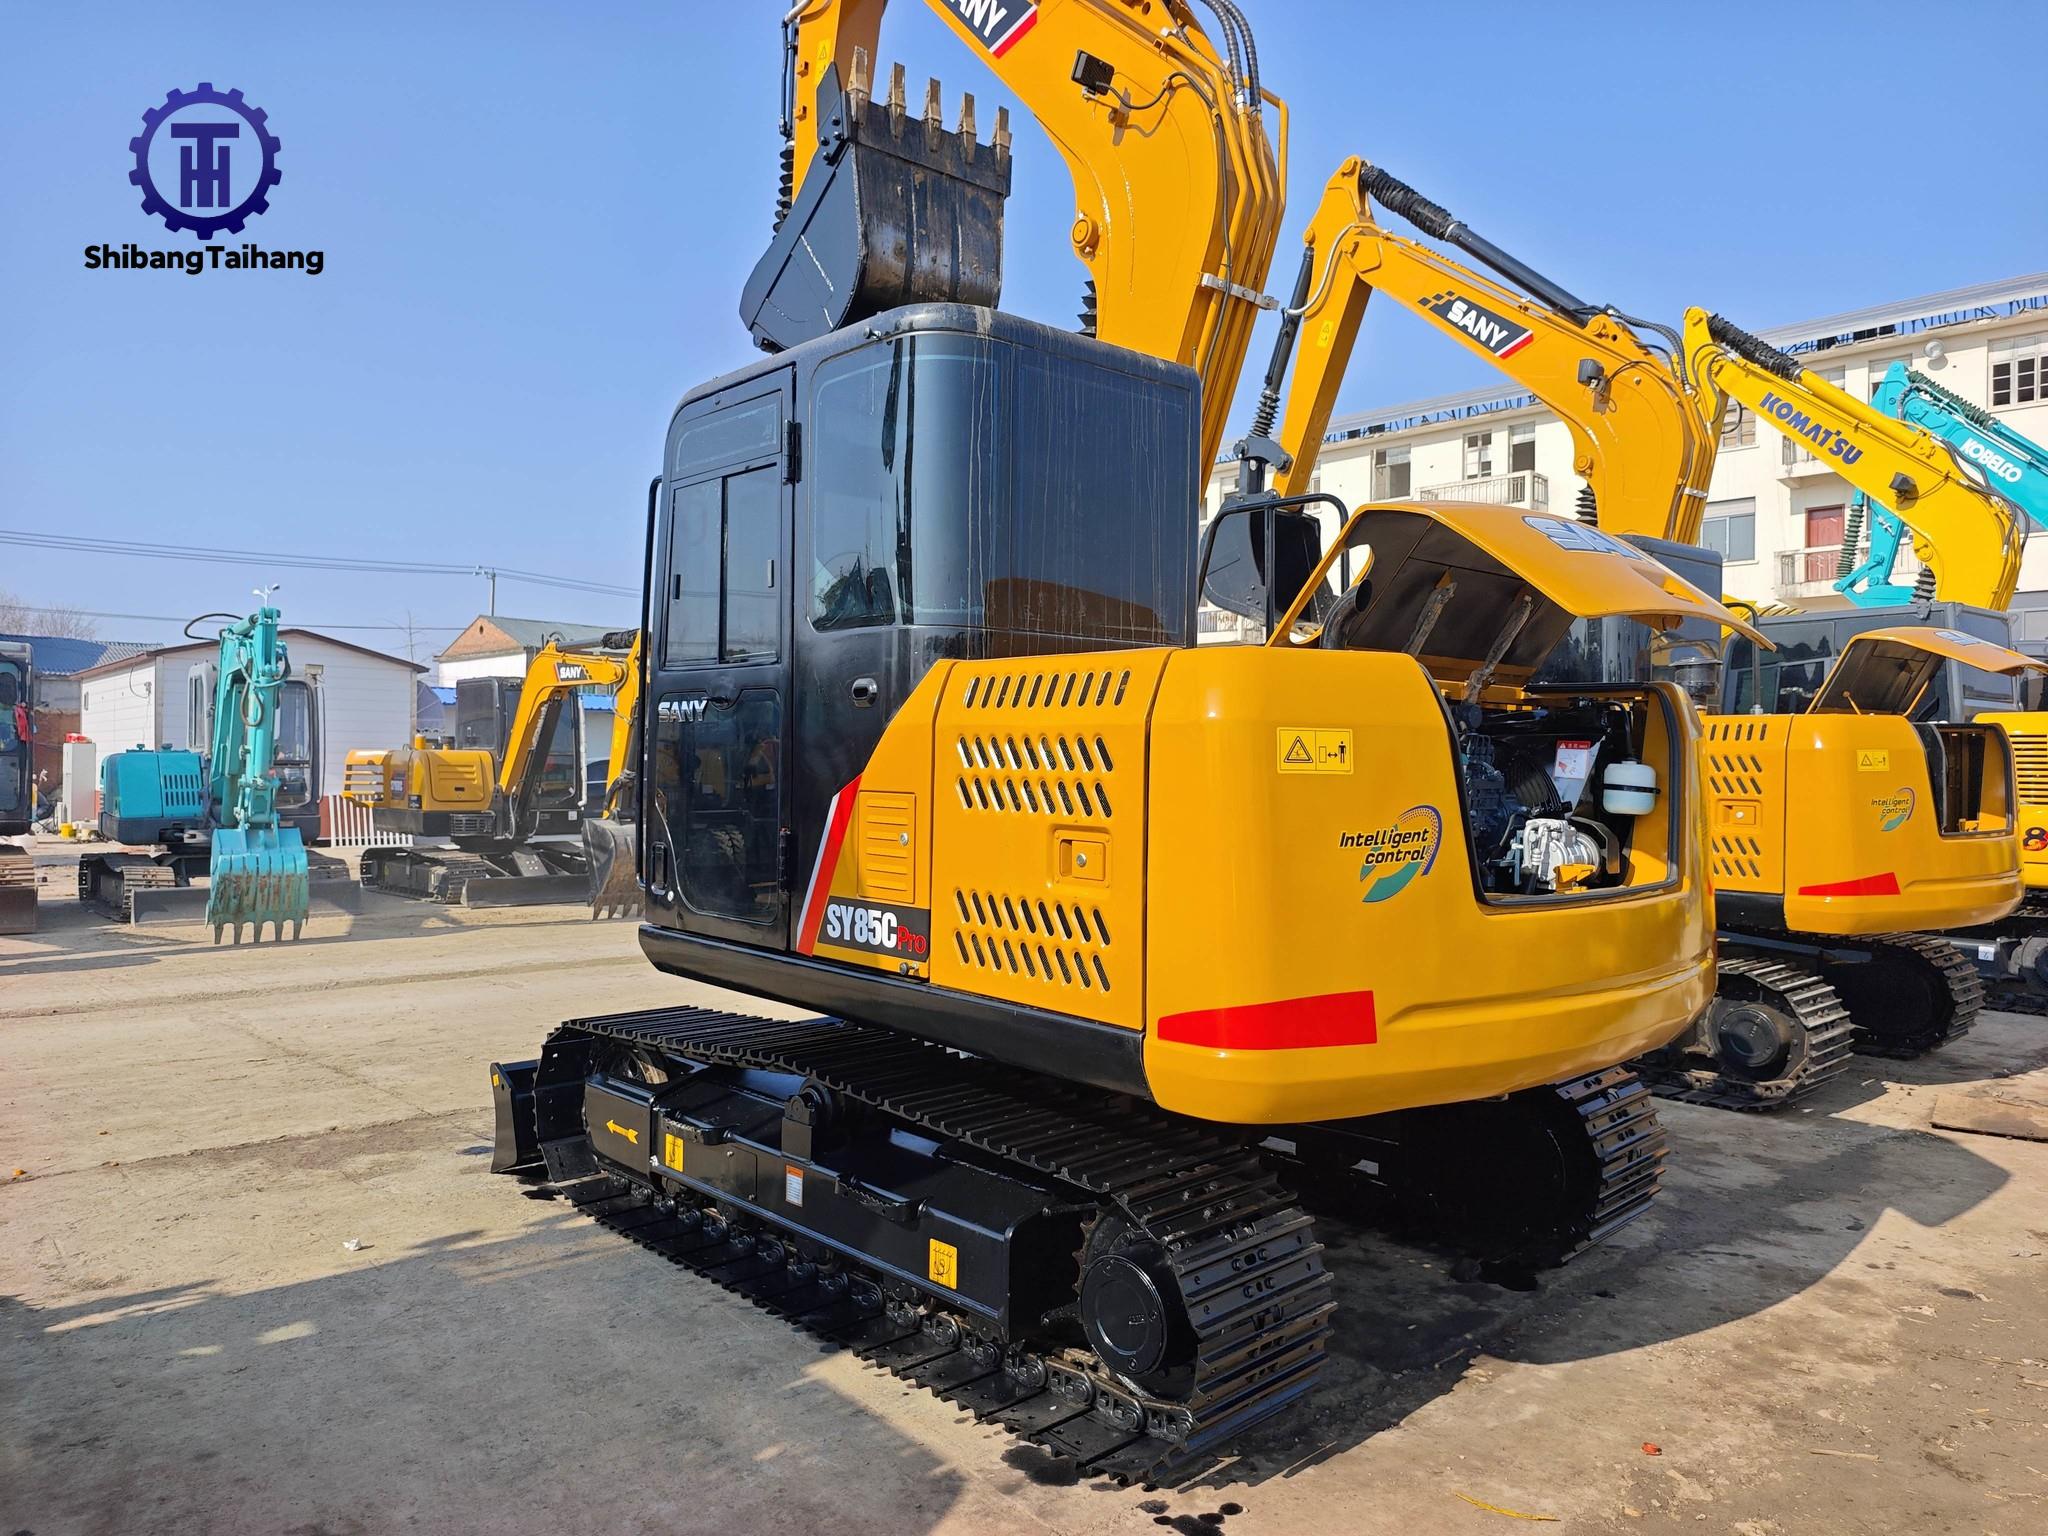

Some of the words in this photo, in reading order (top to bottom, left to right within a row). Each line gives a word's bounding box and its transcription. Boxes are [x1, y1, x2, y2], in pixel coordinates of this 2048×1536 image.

[1446, 300, 1509, 348] SANY
[1759, 391, 1863, 465] KOMATSU
[1960, 437, 2022, 483] KOBELCO
[559, 666, 582, 679] SANY
[658, 700, 708, 723] SANY
[1871, 798, 1910, 807] Intelligent
[1339, 828, 1430, 849] Intelligent
[1365, 845, 1427, 865] control
[826, 903, 898, 949] SY85C
[897, 924, 927, 955] Pro
